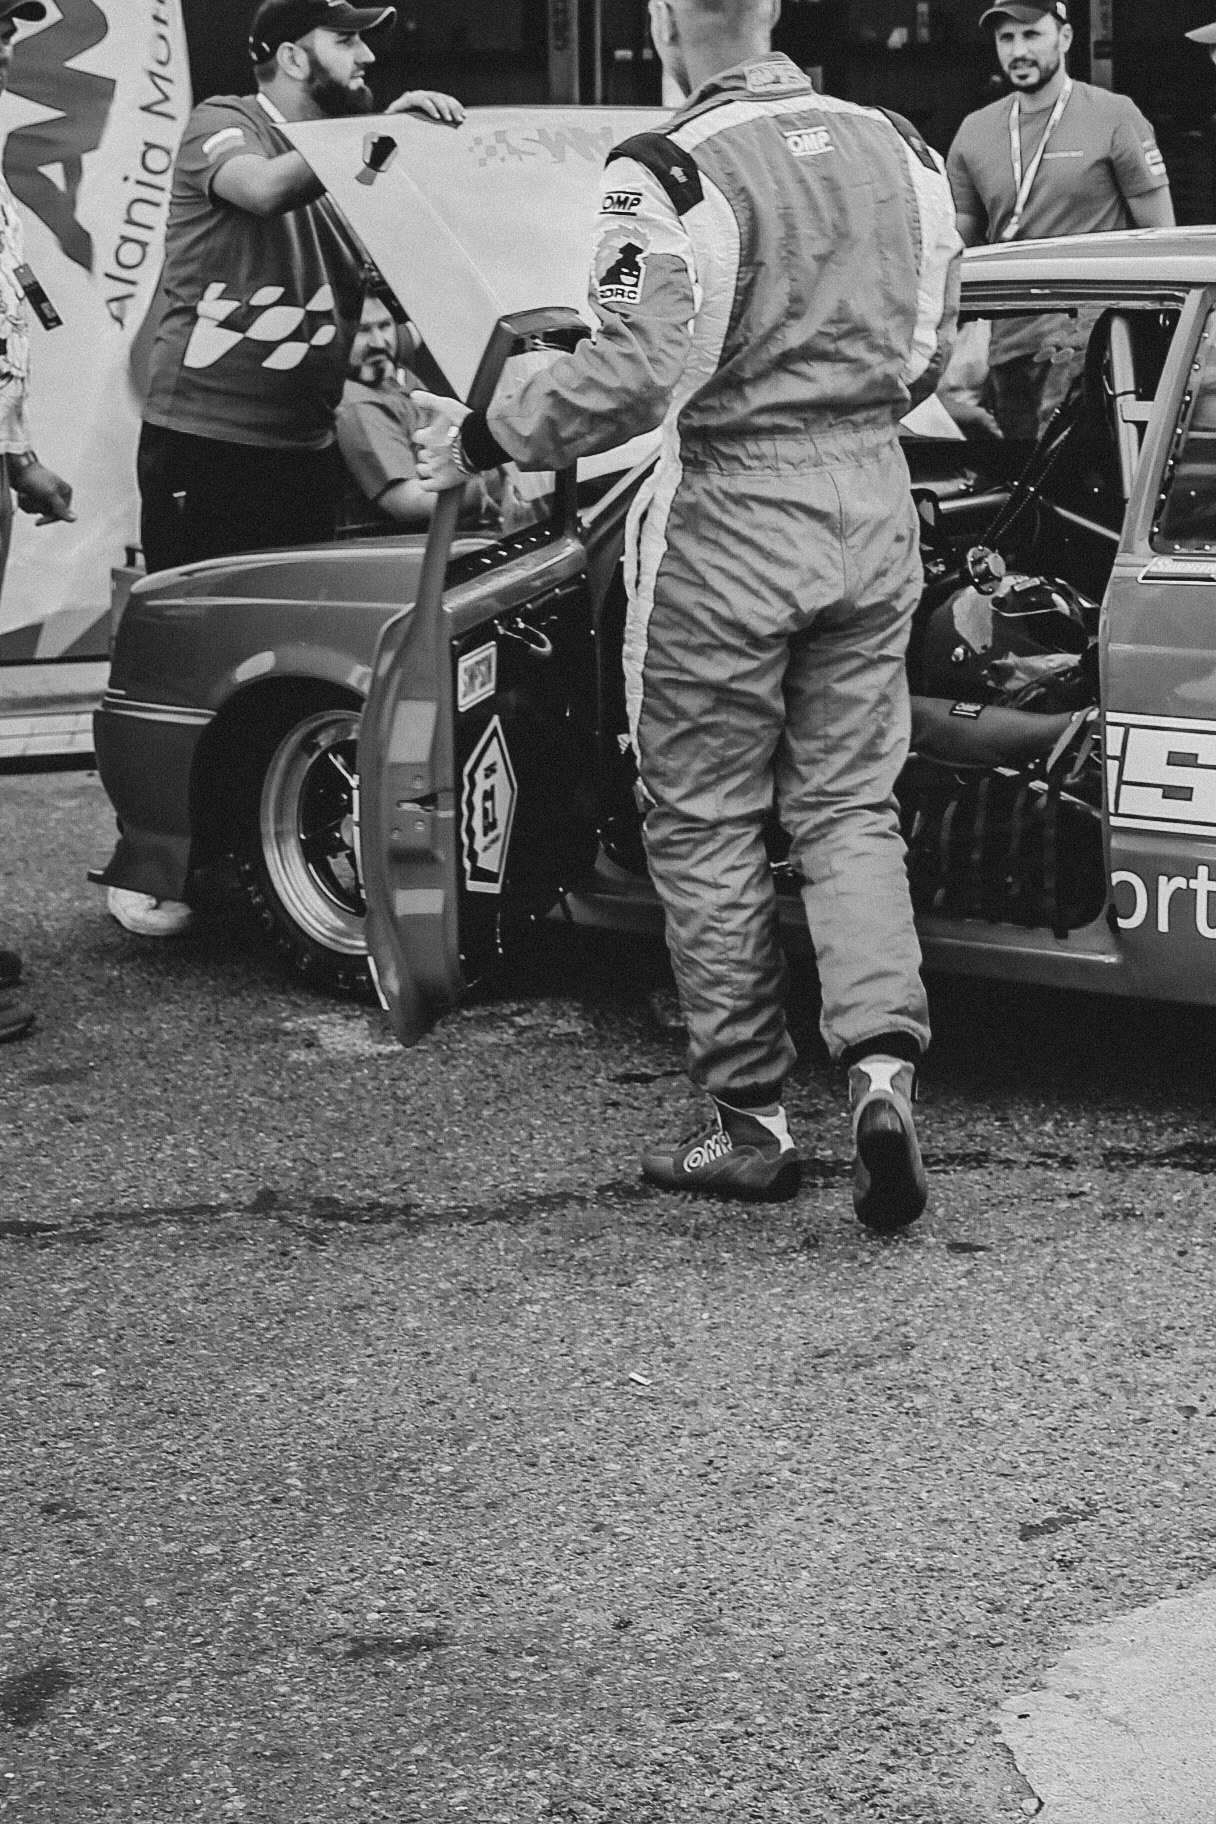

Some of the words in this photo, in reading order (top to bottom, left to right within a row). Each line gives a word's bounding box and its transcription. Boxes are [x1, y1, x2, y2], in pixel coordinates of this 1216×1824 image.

[602, 195, 642, 211] OMP
[105, 141, 172, 330] Alania
[599, 288, 638, 300] DRC
